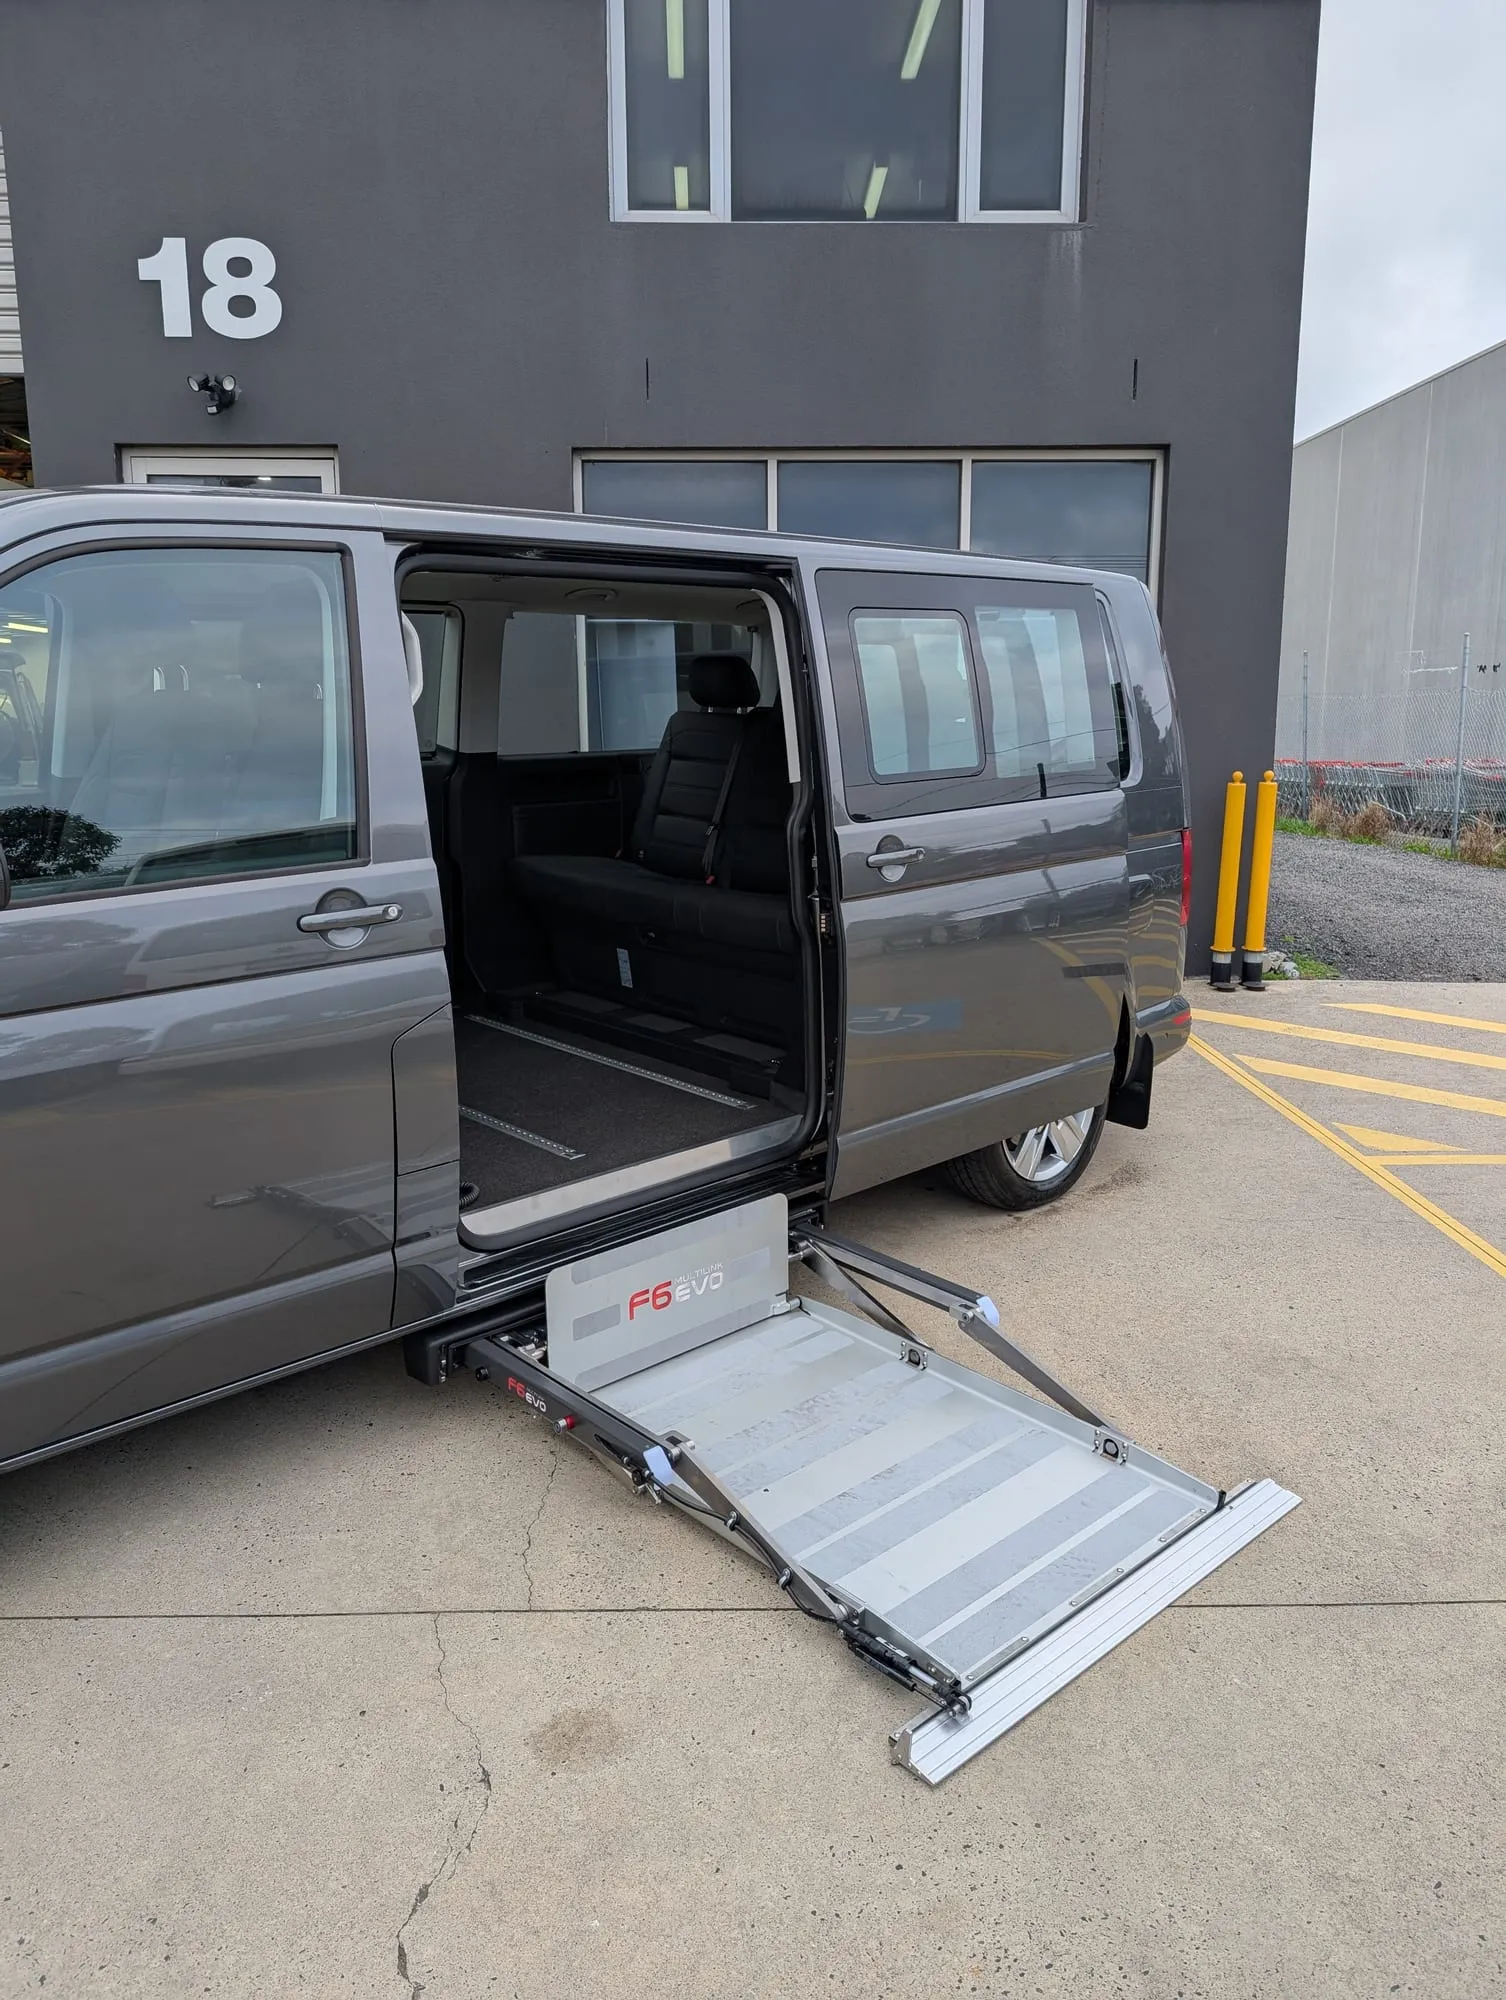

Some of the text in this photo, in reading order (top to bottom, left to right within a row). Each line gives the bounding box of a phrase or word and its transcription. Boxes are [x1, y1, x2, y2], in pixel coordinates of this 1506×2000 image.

[138, 237, 283, 340] 18
[674, 1262, 724, 1285] MULTILINK
[628, 1272, 724, 1321] F6 EVO
[507, 1376, 526, 1399] F6
[525, 1392, 547, 1413] EVO
